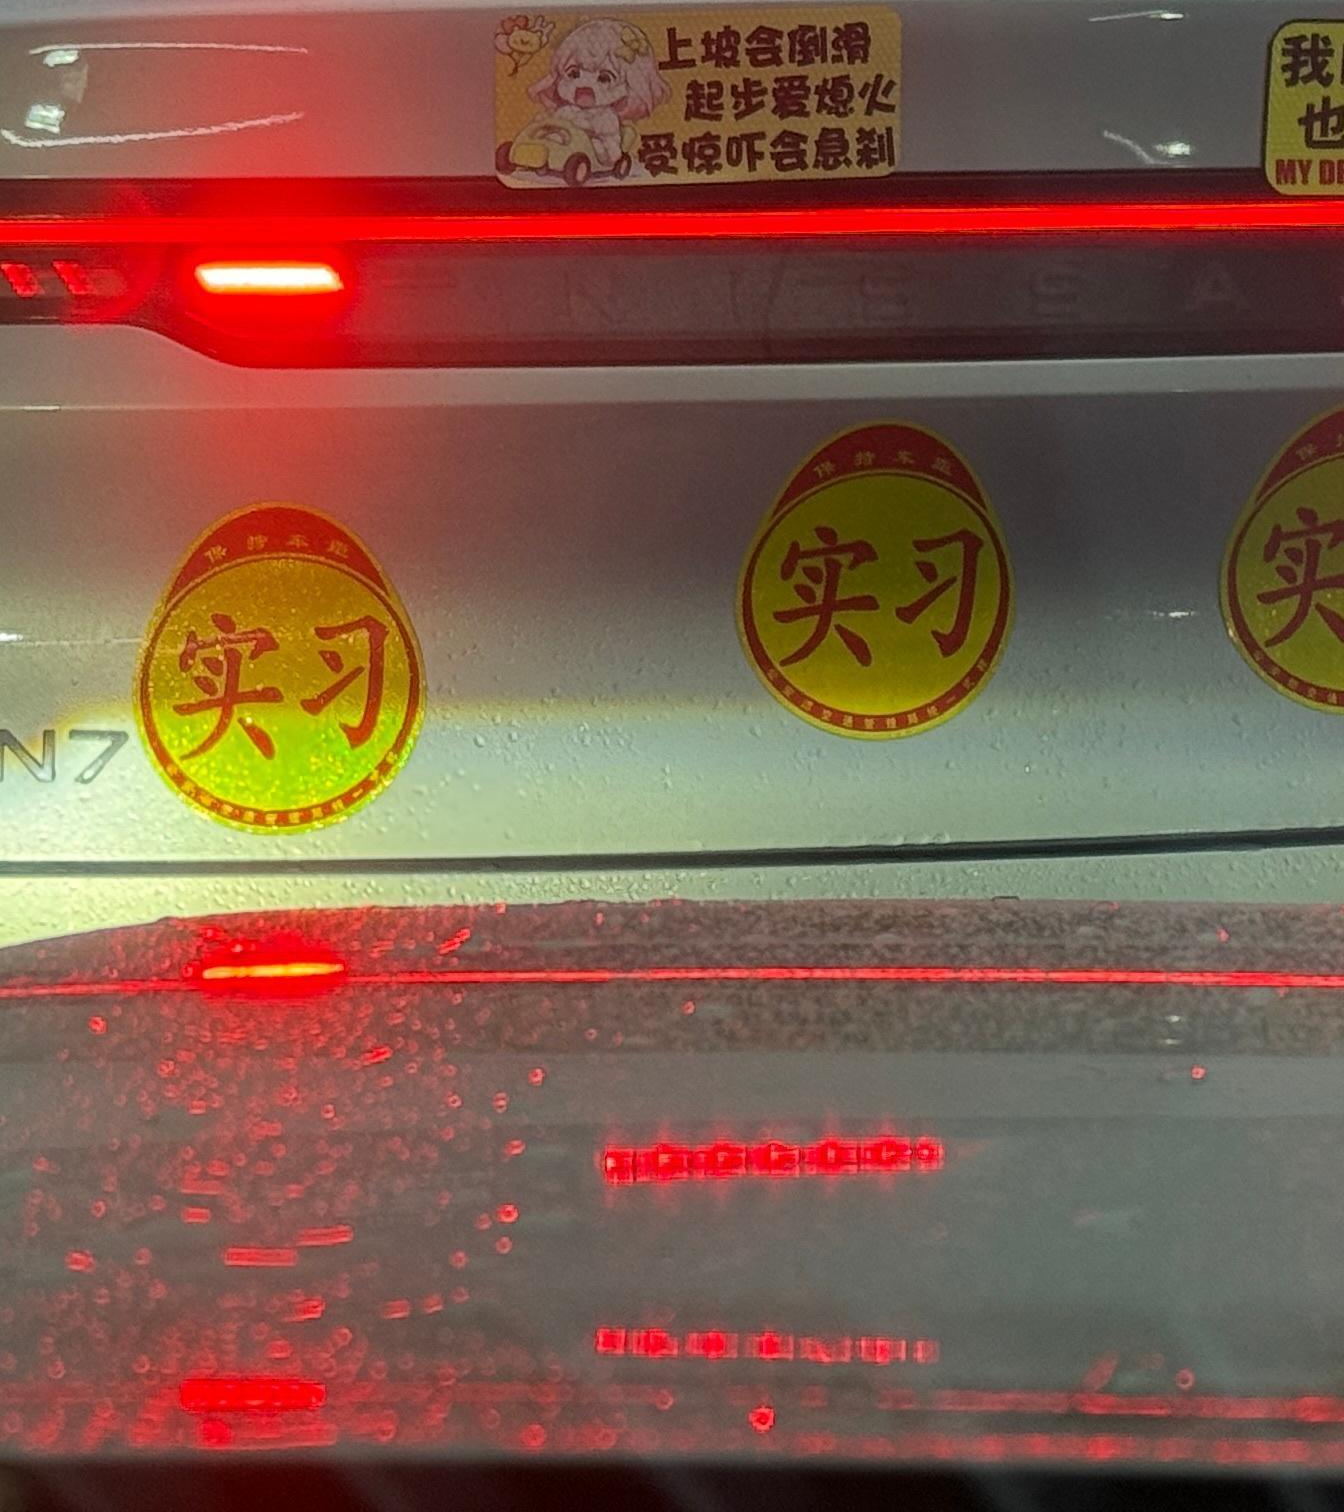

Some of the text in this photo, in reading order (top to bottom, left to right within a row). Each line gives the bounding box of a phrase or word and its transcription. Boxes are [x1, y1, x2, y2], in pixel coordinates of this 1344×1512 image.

[658, 21, 872, 71] 上坡会倒滑
[684, 73, 898, 122] 起步爱熄火
[638, 126, 897, 177] 受惊吓会急刹
[1275, 159, 1313, 186] MY
[772, 525, 985, 668] 实习
[173, 613, 389, 761] 实习
